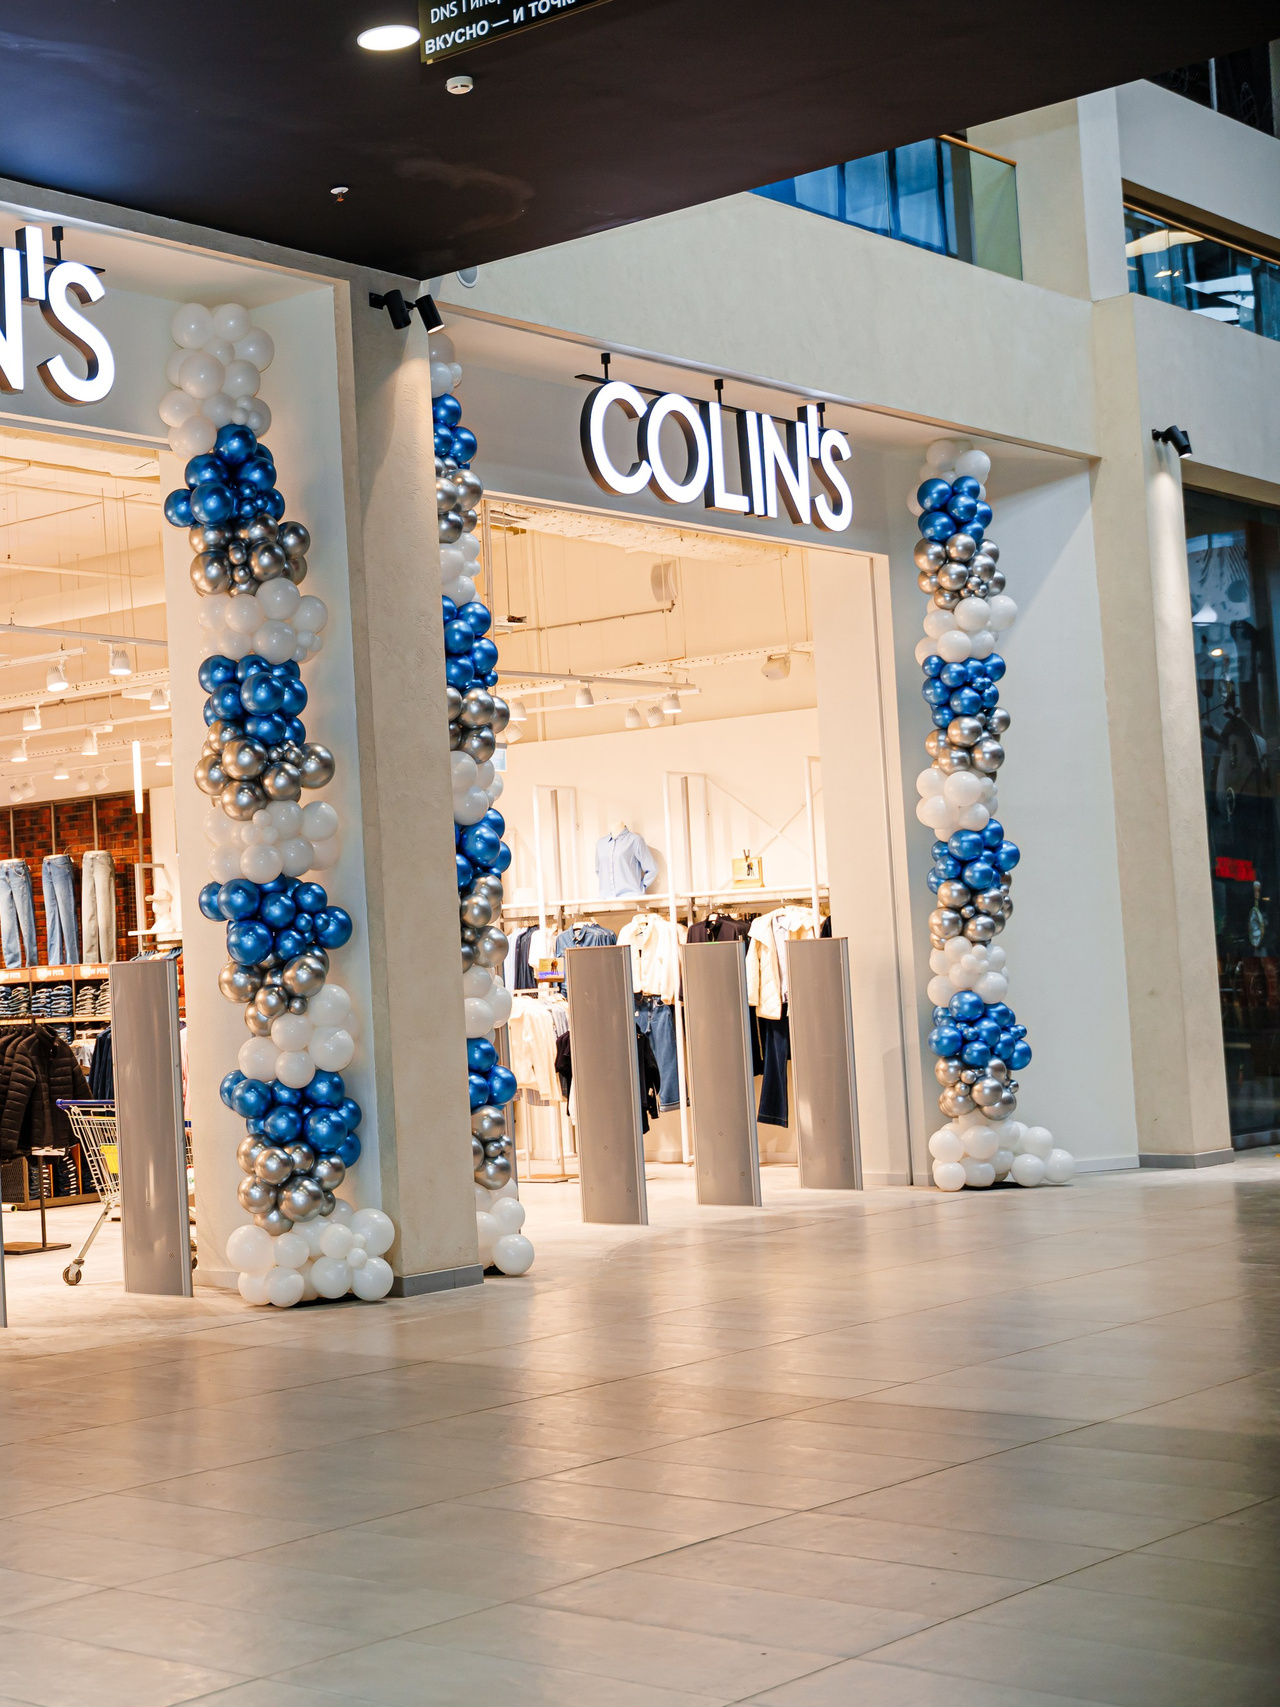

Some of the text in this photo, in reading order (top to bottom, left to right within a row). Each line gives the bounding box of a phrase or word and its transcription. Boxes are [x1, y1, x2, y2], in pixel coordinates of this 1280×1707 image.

[425, 20, 489, 55] ВКУСНО
[512, 6, 525, 24] И
[430, 1, 458, 24] DNS
[580, 381, 853, 532] COLIN'S
